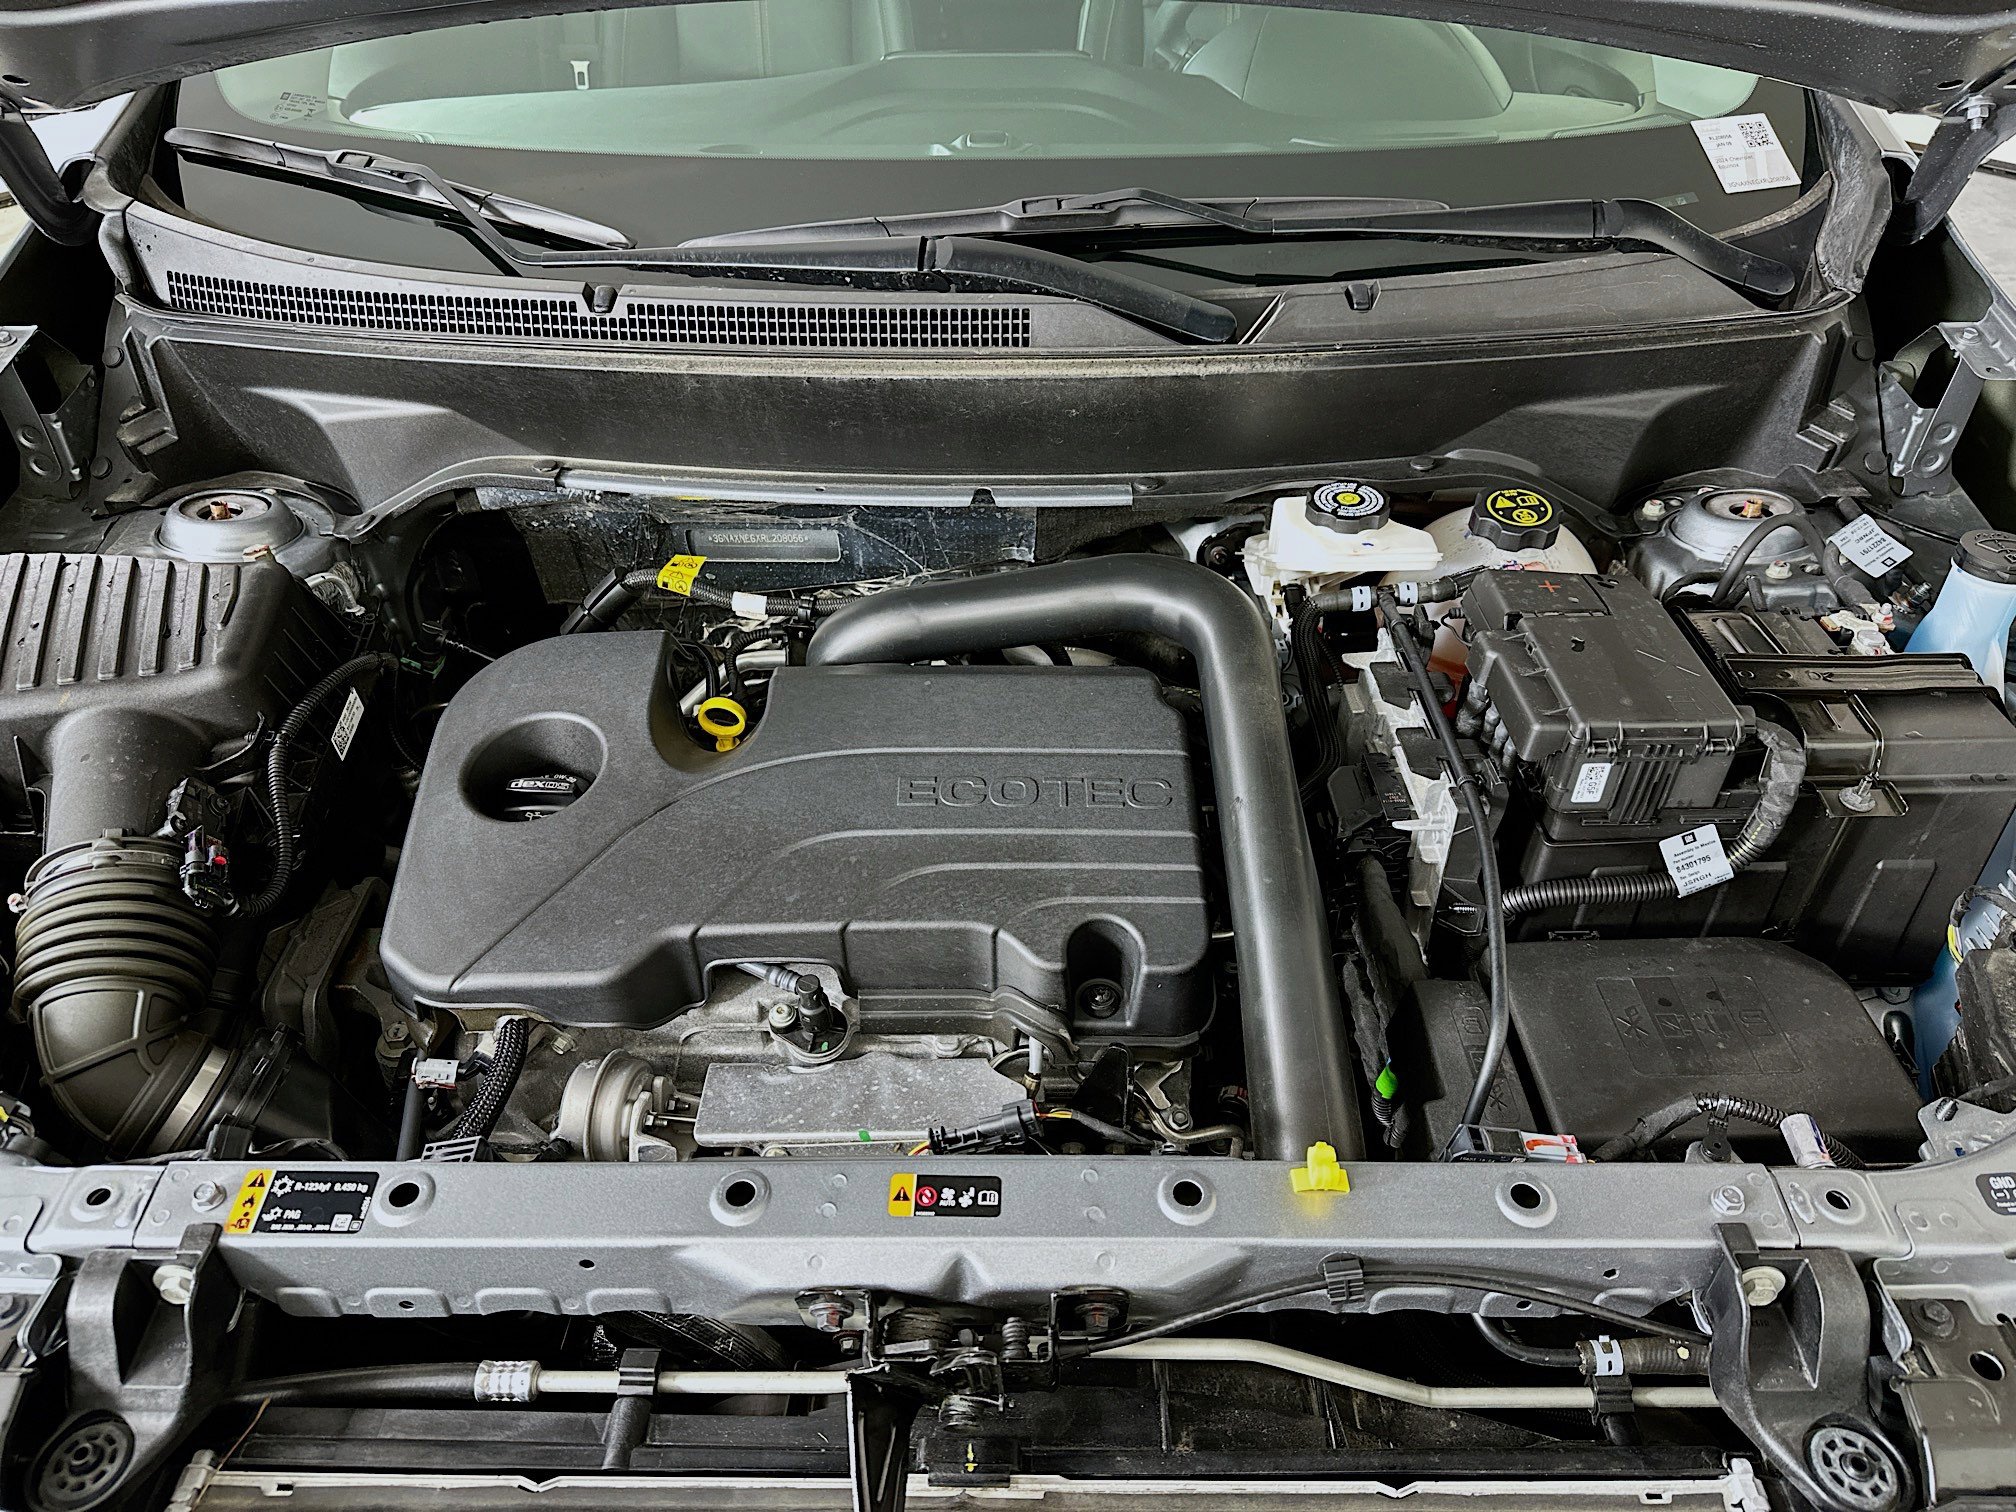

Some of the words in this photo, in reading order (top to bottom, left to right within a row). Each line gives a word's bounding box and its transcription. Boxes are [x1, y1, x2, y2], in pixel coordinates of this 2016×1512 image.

[510, 780, 571, 790] dexos
[897, 776, 1173, 809] ECOTEC
[1676, 855, 1712, 873] 84301795
[356, 1182, 369, 1193] kg
[1989, 1176, 2016, 1189] GND
[283, 1210, 301, 1220] PAG
